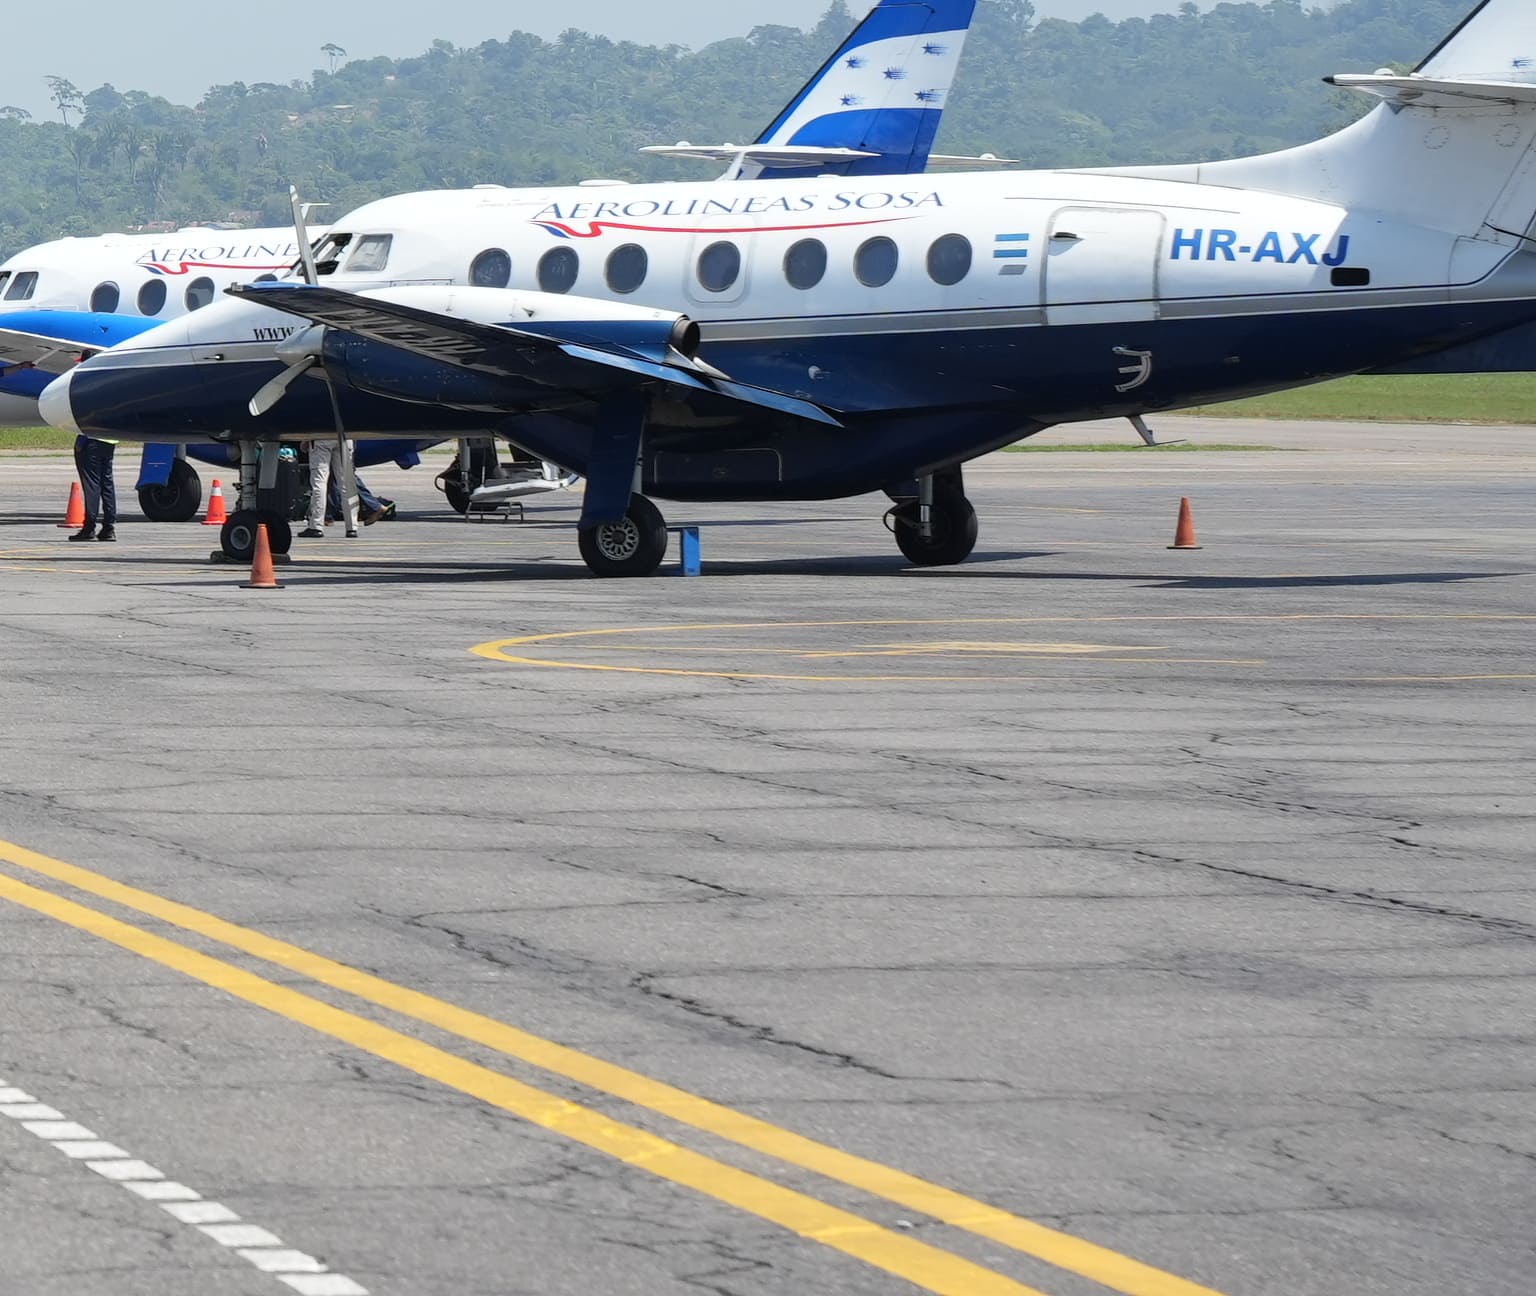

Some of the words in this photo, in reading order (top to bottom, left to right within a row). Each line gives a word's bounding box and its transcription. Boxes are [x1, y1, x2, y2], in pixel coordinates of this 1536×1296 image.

[530, 194, 818, 219] AEROLINEAS
[827, 191, 945, 211] SOSA
[135, 243, 300, 264] AEROLINE
[1169, 228, 1350, 267] HR-AXJ
